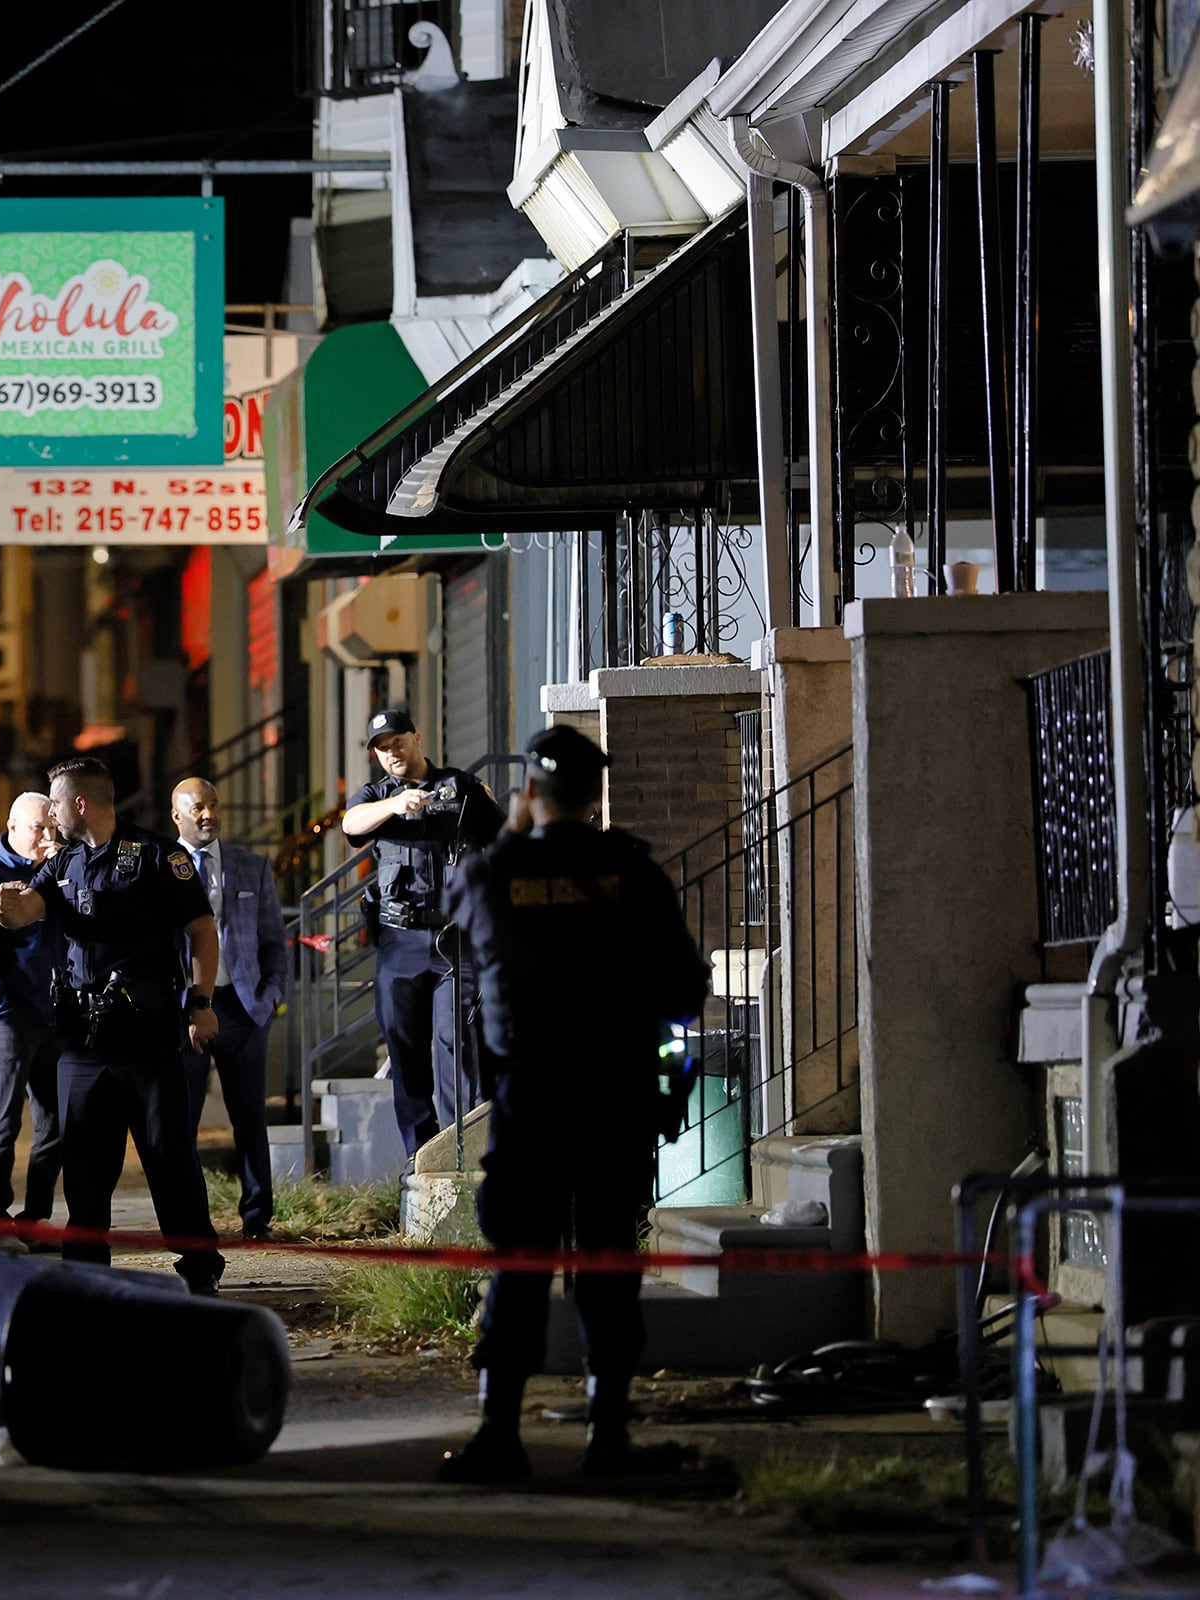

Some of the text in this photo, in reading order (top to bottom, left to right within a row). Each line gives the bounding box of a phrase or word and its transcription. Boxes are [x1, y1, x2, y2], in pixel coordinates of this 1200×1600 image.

[1, 340, 161, 355] MEXICAN GRILL
[28, 480, 92, 495] 132
[113, 480, 147, 495] N.
[12, 507, 268, 532] Tel: 215-747-855
